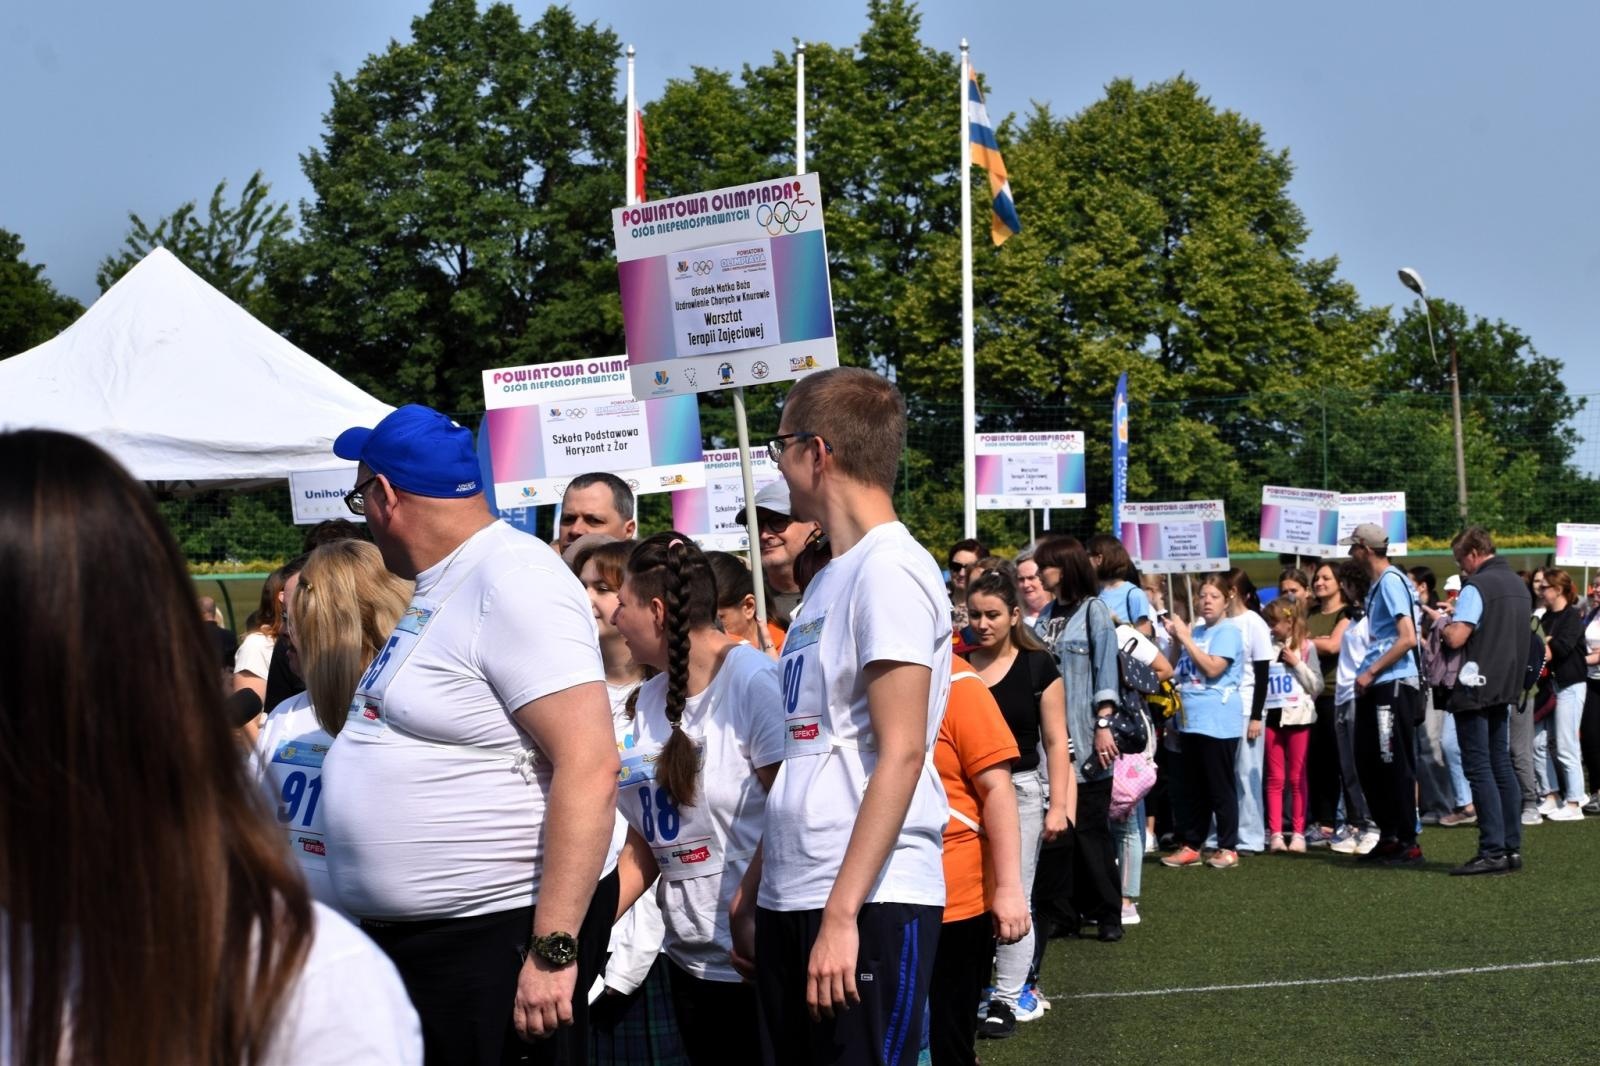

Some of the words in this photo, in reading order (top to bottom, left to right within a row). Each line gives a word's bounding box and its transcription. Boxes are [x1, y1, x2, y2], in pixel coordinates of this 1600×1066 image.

[622, 197, 709, 227] POWIATOWA
[711, 182, 793, 212] OLIMPIADA
[631, 226, 656, 239] OSÓB
[657, 209, 750, 234] NIEPEŁNOSPRAWNYCH
[691, 284, 716, 297] Ośrodek
[717, 282, 735, 293] Matka
[675, 299, 709, 311] Uzdrowienie
[711, 294, 735, 306] Chorych
[742, 289, 770, 301] Knurowie
[704, 309, 743, 326] Warsztat
[688, 329, 716, 347] Terapii
[718, 323, 764, 344] Zajęciowej
[493, 363, 585, 385] POWIATOWA
[588, 359, 630, 376] OLIMP
[503, 383, 529, 393] OSÓB
[530, 373, 625, 390] NIEPEŁNOSPRAWNYCH
[552, 432, 582, 445] Szkoła
[585, 428, 639, 441] Podstawowa
[565, 444, 605, 456] Horyzont
[607, 443, 612, 451] z
[704, 452, 738, 463] ATOWA
[305, 488, 352, 499] Unihok
[1269, 675, 1293, 695] 118
[794, 729, 816, 739] EFEKT
[277, 771, 322, 827] 91
[639, 786, 680, 842] 88
